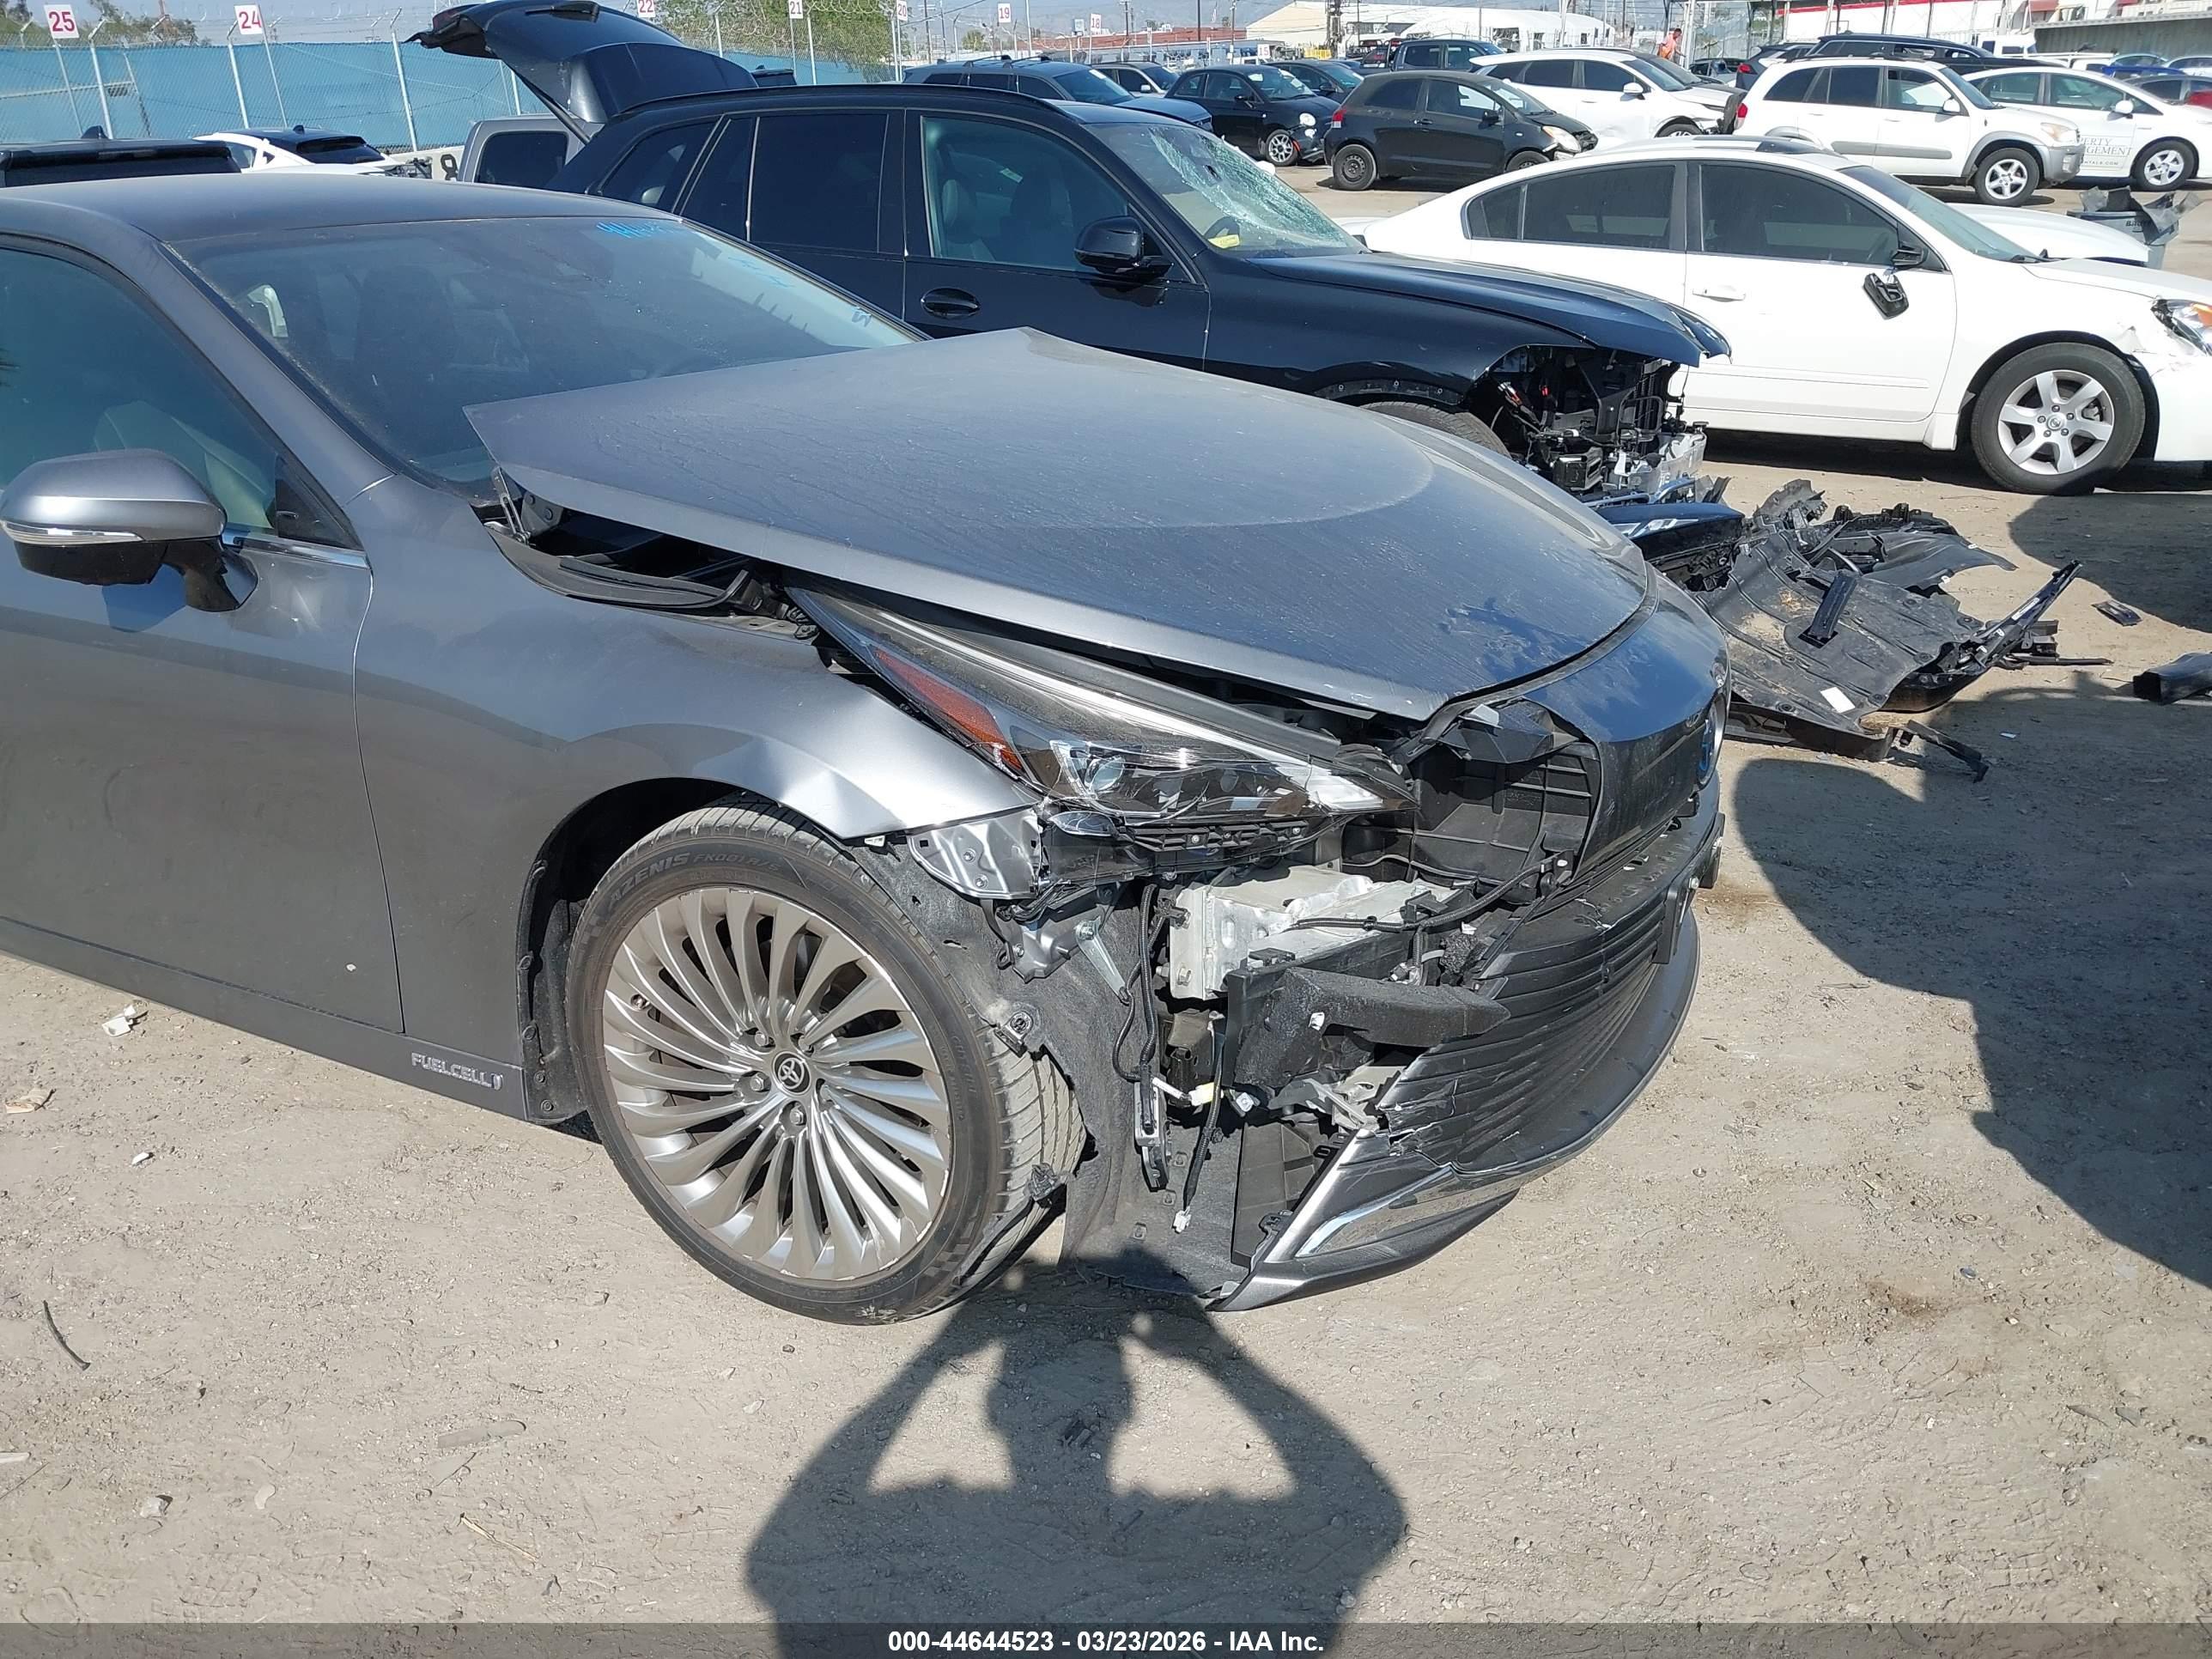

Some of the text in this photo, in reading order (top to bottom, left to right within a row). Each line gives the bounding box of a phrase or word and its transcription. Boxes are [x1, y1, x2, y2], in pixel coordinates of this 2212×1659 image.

[638, 0, 654, 13] 22
[789, 1, 802, 15] 21
[897, 3, 908, 17] 20
[999, 7, 1010, 19] 19
[49, 11, 76, 32] 25
[239, 10, 262, 29] 24
[1091, 17, 1101, 28] 18
[1259, 46, 1269, 56] 15
